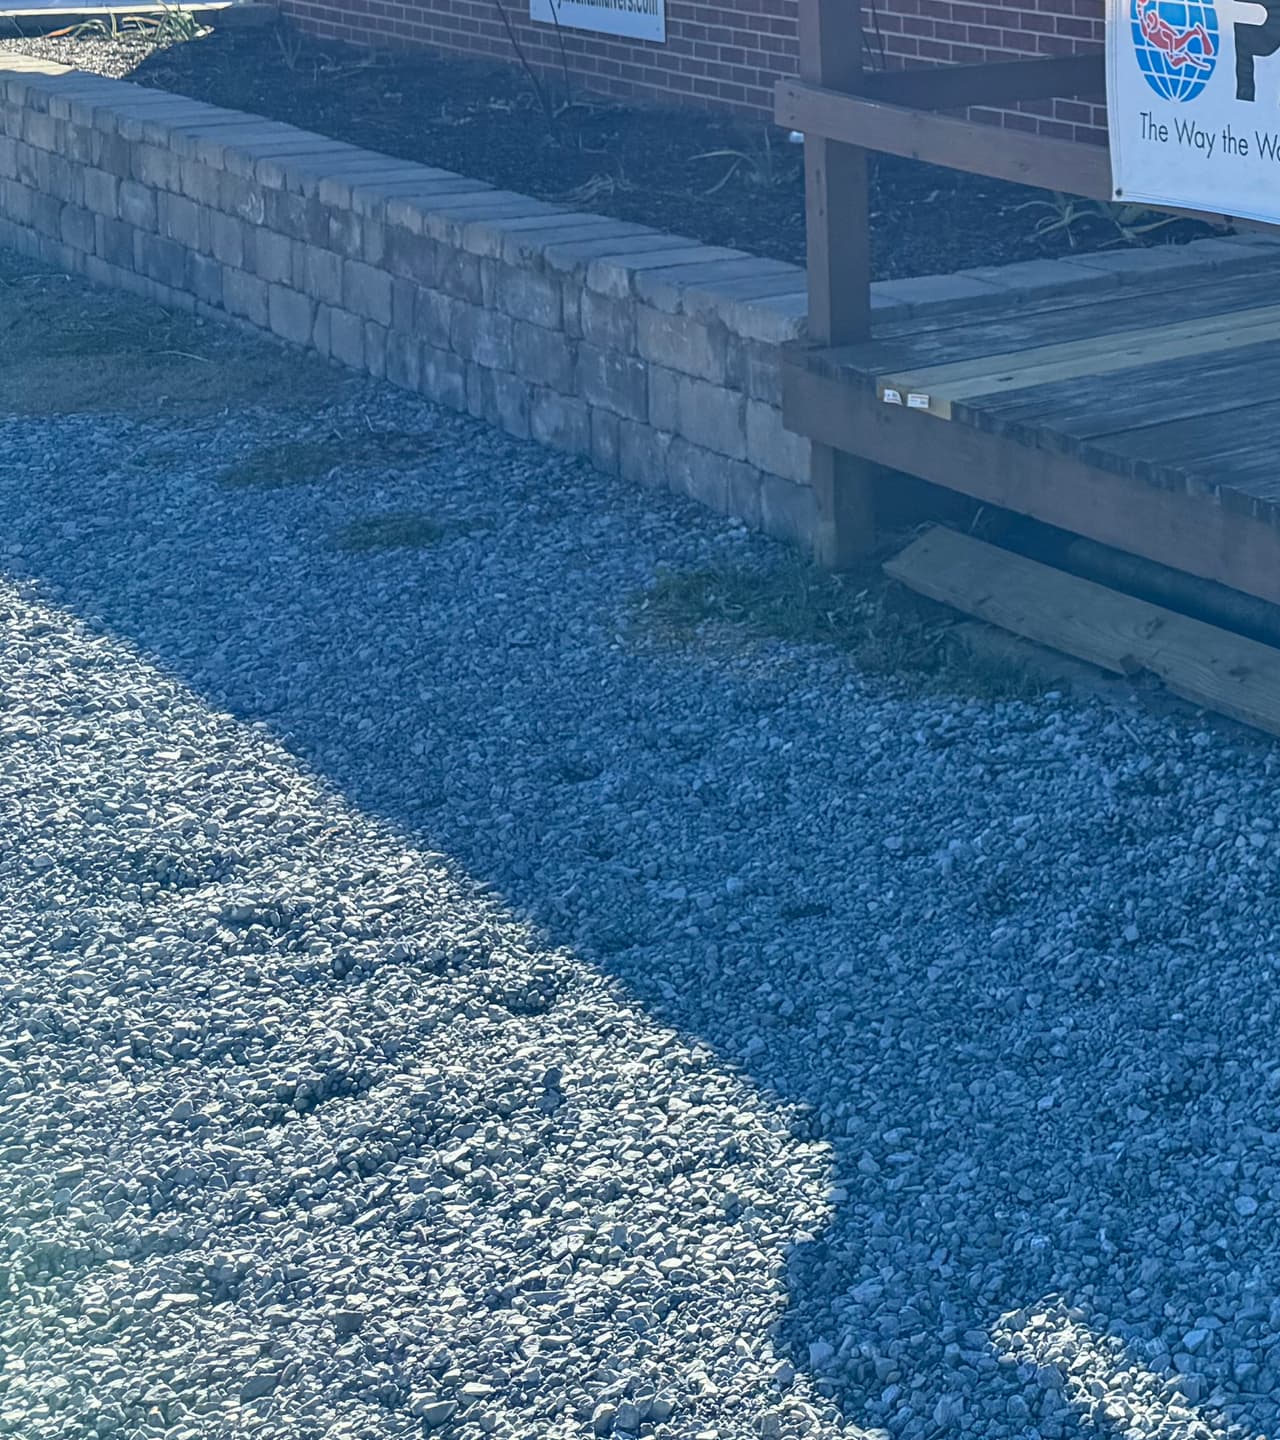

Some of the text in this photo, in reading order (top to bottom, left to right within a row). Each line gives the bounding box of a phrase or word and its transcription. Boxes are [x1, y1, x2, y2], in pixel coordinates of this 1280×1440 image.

[1139, 112, 1168, 142] The
[1174, 117, 1216, 158] Way
[1222, 124, 1249, 157] the
